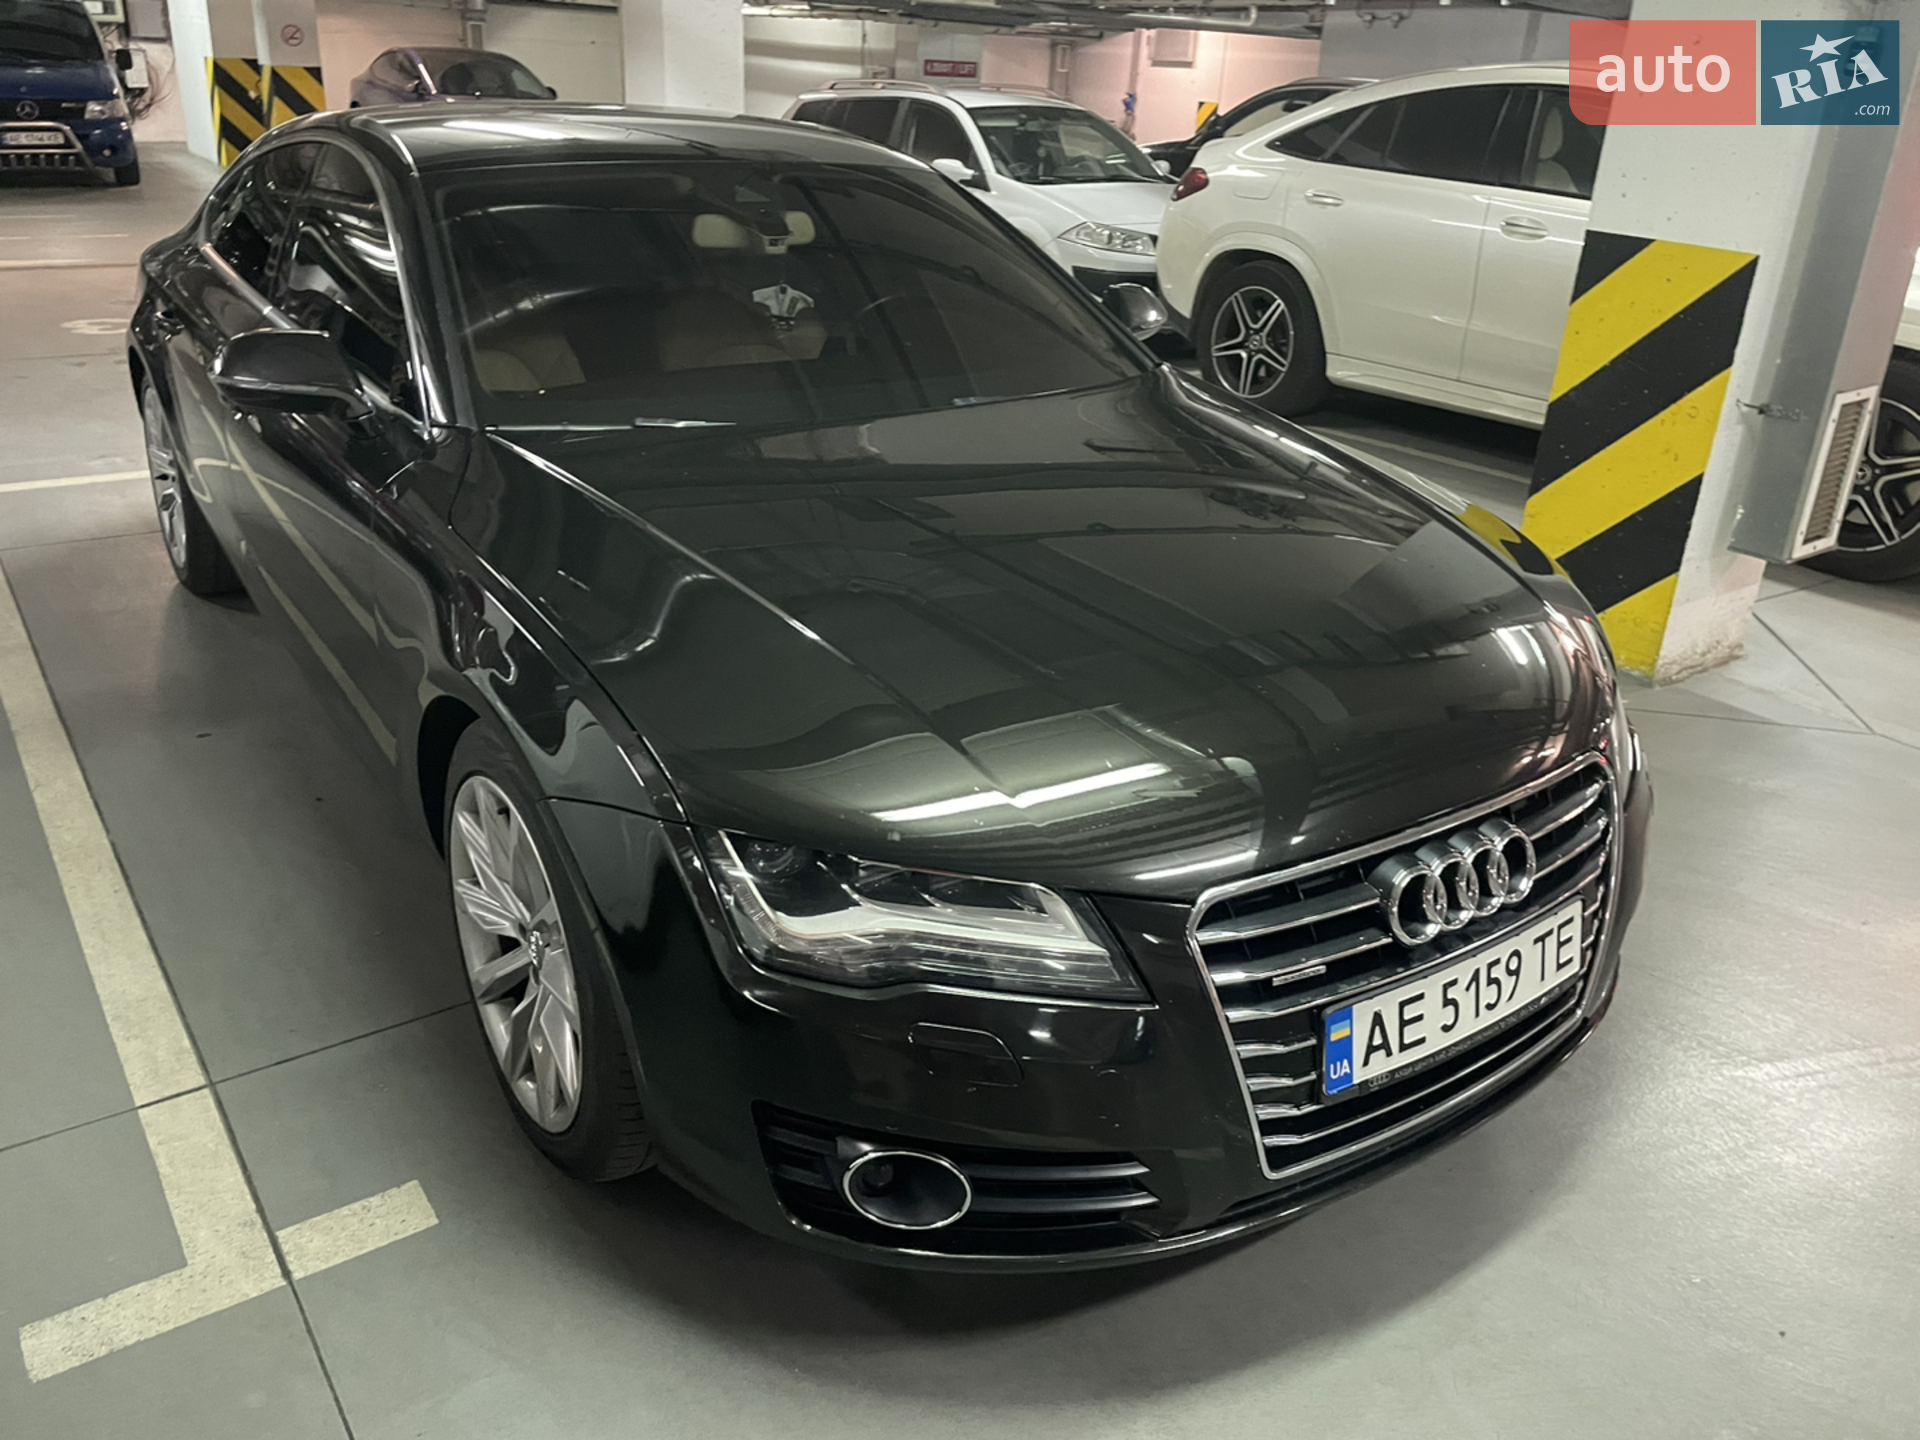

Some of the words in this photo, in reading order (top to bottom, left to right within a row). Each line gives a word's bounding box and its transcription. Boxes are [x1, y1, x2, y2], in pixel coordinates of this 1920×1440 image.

[1362, 992, 1427, 1068] AE
[1441, 949, 1522, 1033] 5159
[1533, 916, 1575, 982] TE
[1330, 1059, 1351, 1080] UA
